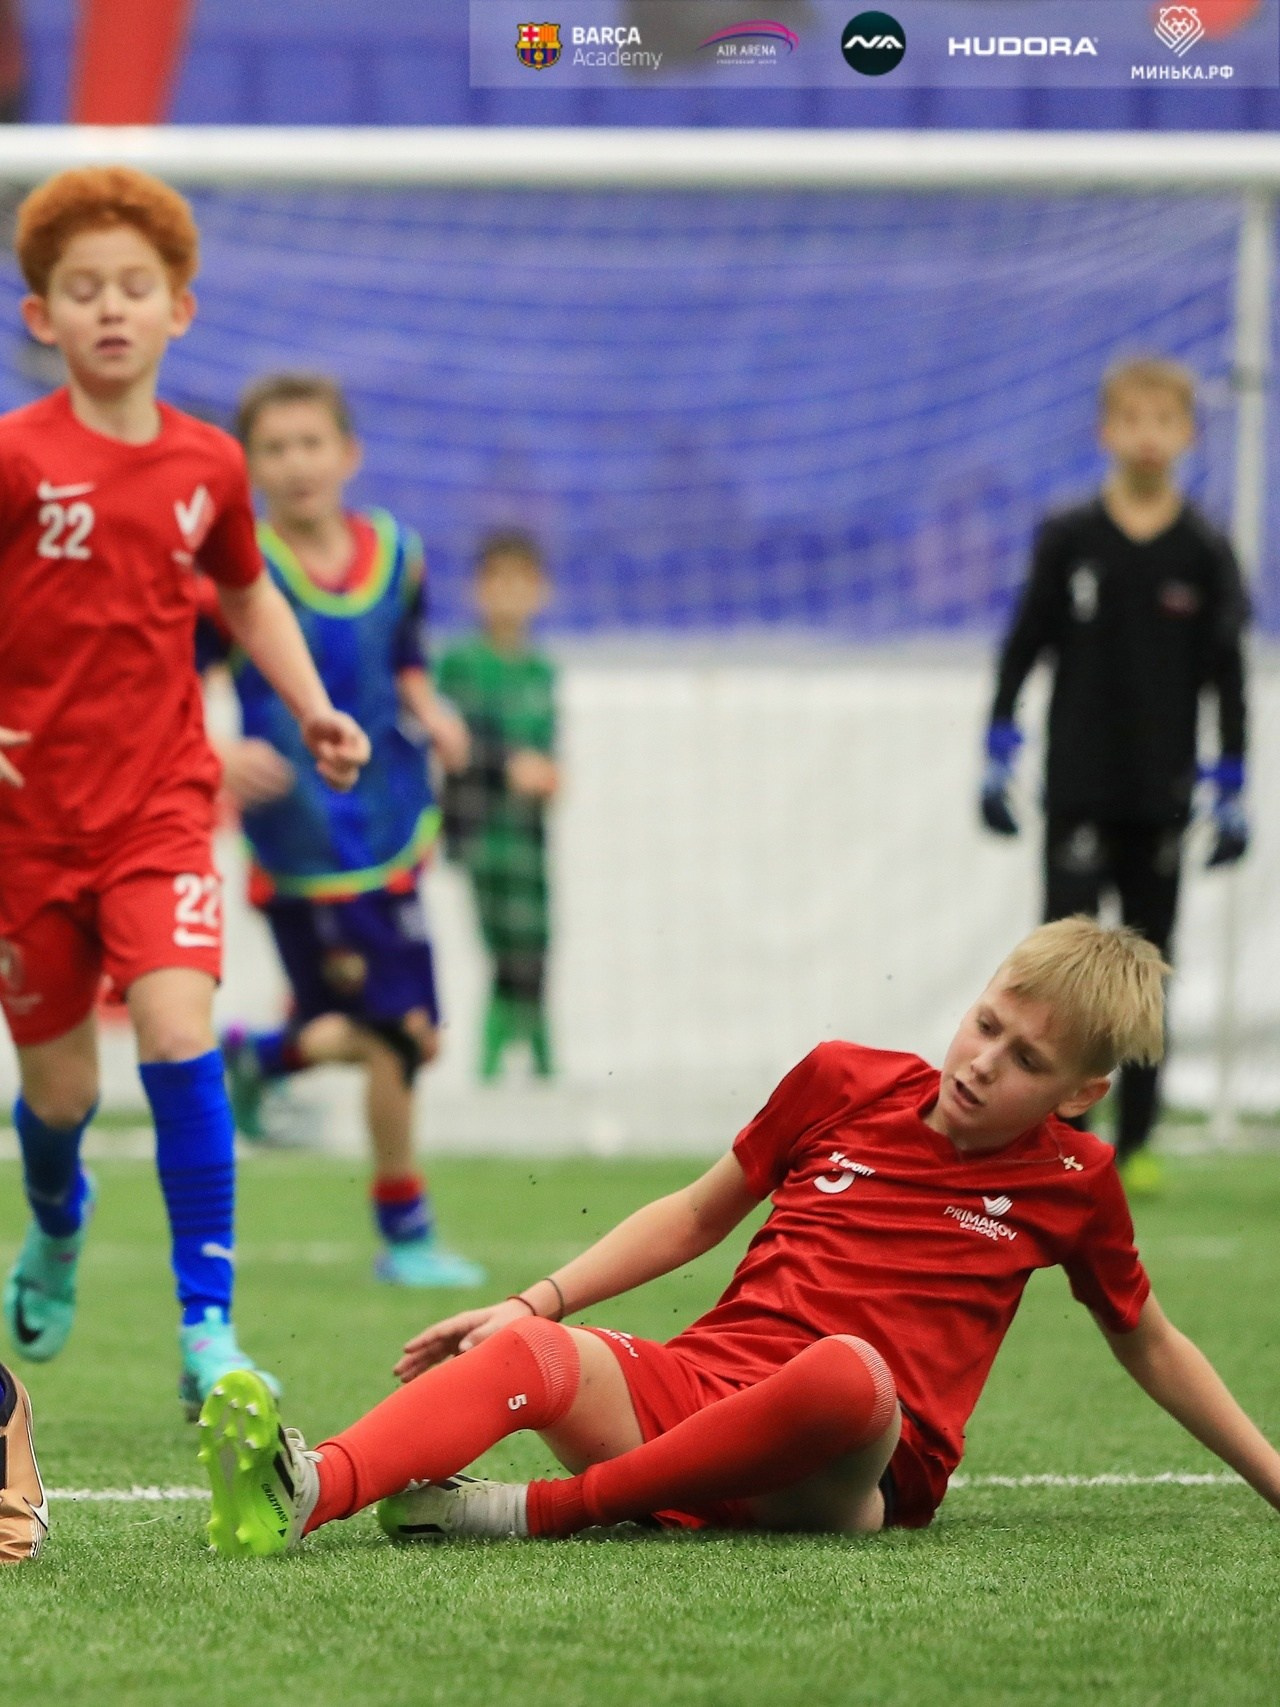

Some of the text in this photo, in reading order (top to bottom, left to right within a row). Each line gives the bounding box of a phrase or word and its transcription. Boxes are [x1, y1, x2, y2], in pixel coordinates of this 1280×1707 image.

[37, 502, 95, 560] 22
[173, 872, 222, 928] 22
[838, 1158, 876, 1176] SPORT
[943, 1205, 1018, 1241] PRIMAKOV
[959, 1221, 999, 1241] SCHOOL
[507, 1393, 528, 1410] 5
